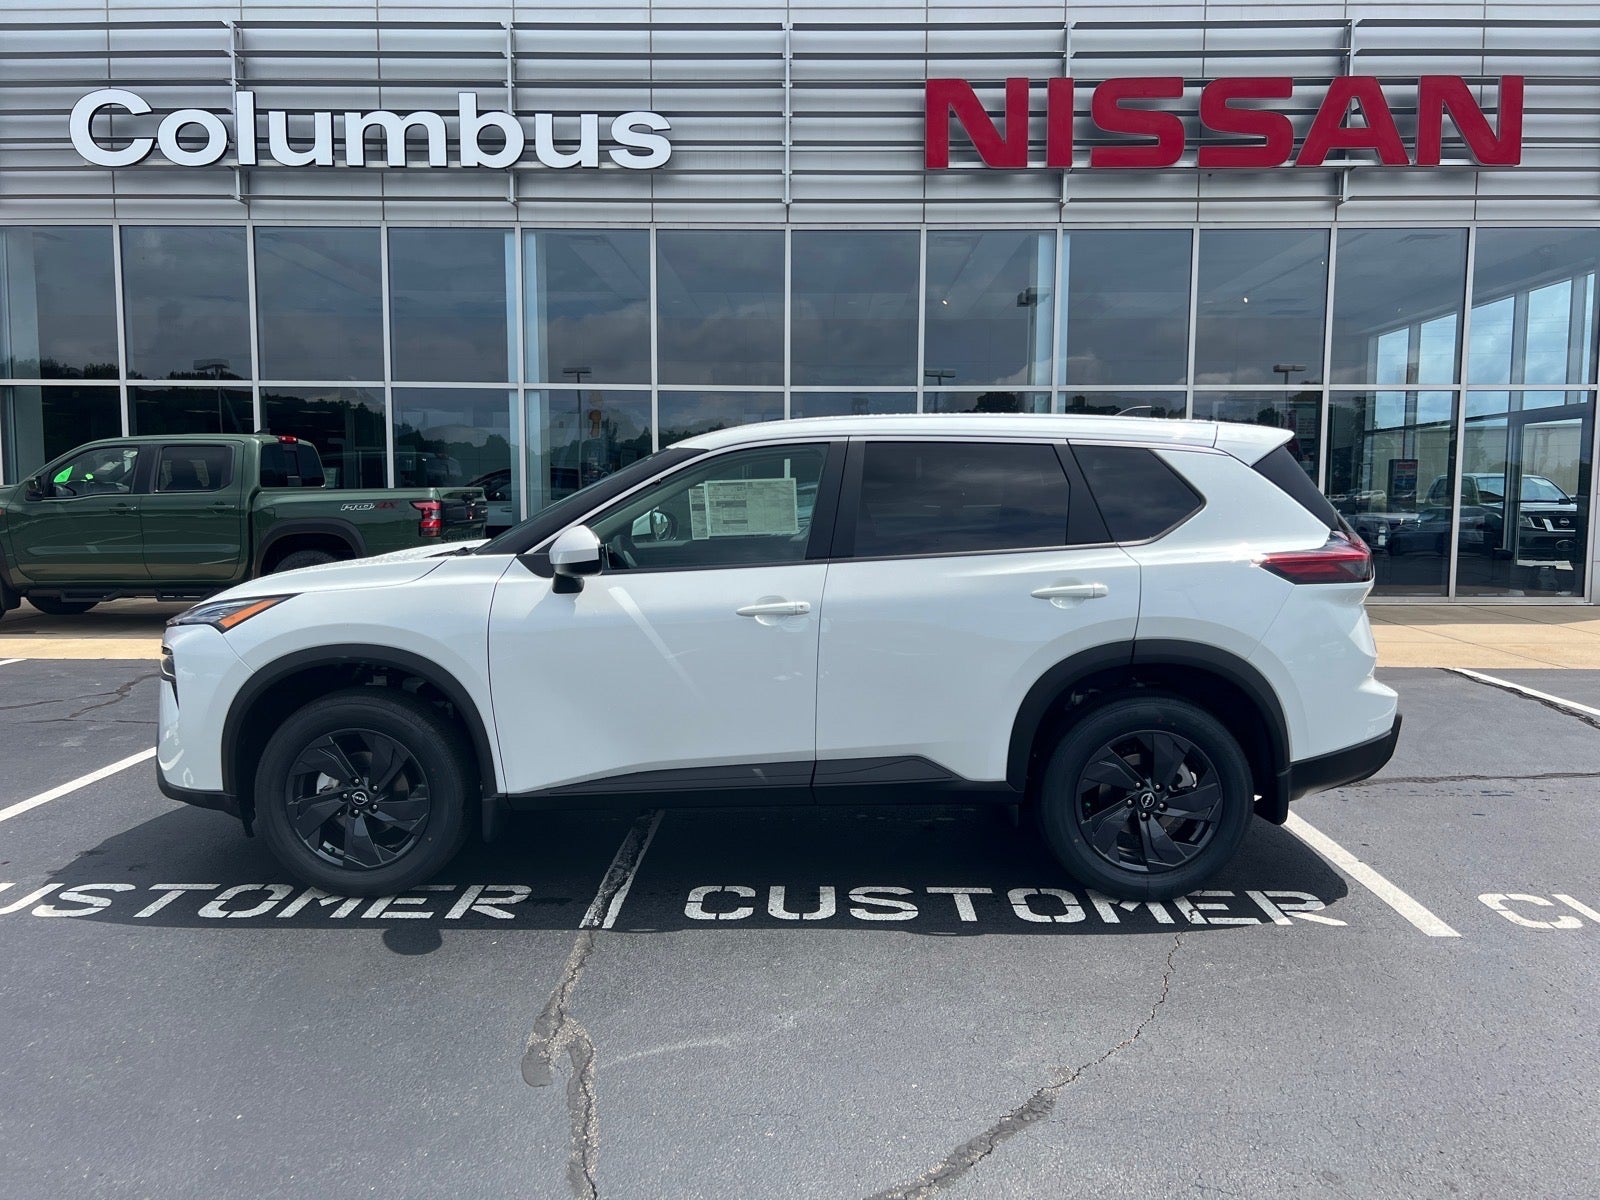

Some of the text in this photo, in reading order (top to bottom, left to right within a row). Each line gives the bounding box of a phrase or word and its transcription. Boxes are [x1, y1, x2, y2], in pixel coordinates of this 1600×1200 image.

[69, 88, 673, 169] Columbus
[925, 76, 1524, 169] NISSAN
[685, 886, 1348, 926] CUSTOMER
